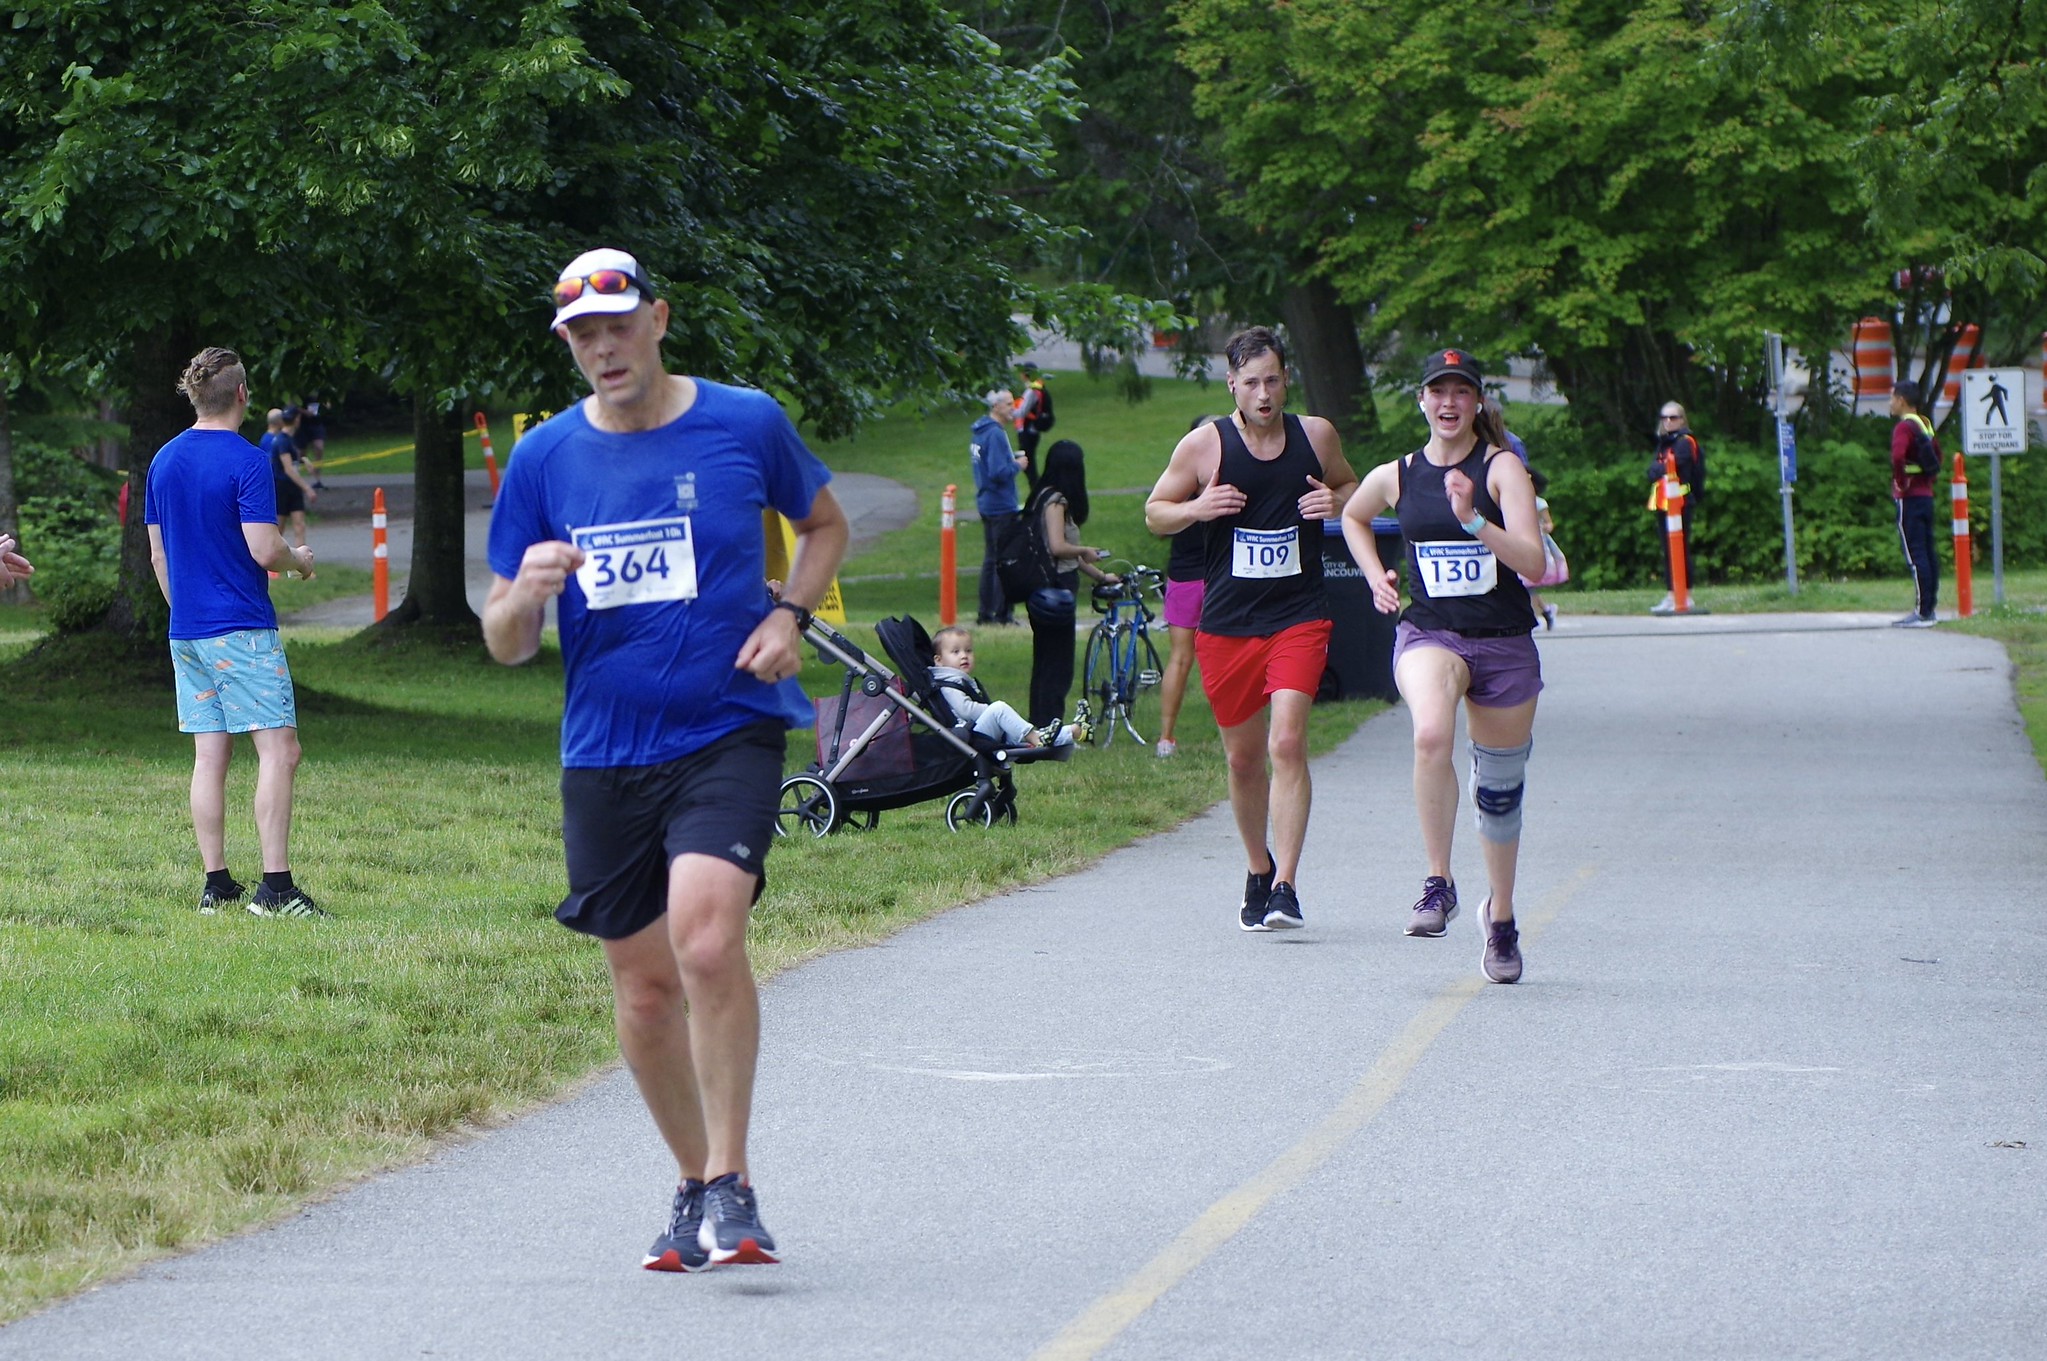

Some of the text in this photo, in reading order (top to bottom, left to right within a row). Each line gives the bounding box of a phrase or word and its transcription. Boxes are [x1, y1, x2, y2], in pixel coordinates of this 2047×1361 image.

[1973, 441, 2020, 449] PEDESTRIANS
[1979, 431, 2013, 440] STOP FOR
[1246, 545, 1289, 566] 109
[593, 546, 670, 587] 364
[1431, 559, 1480, 582] 130
